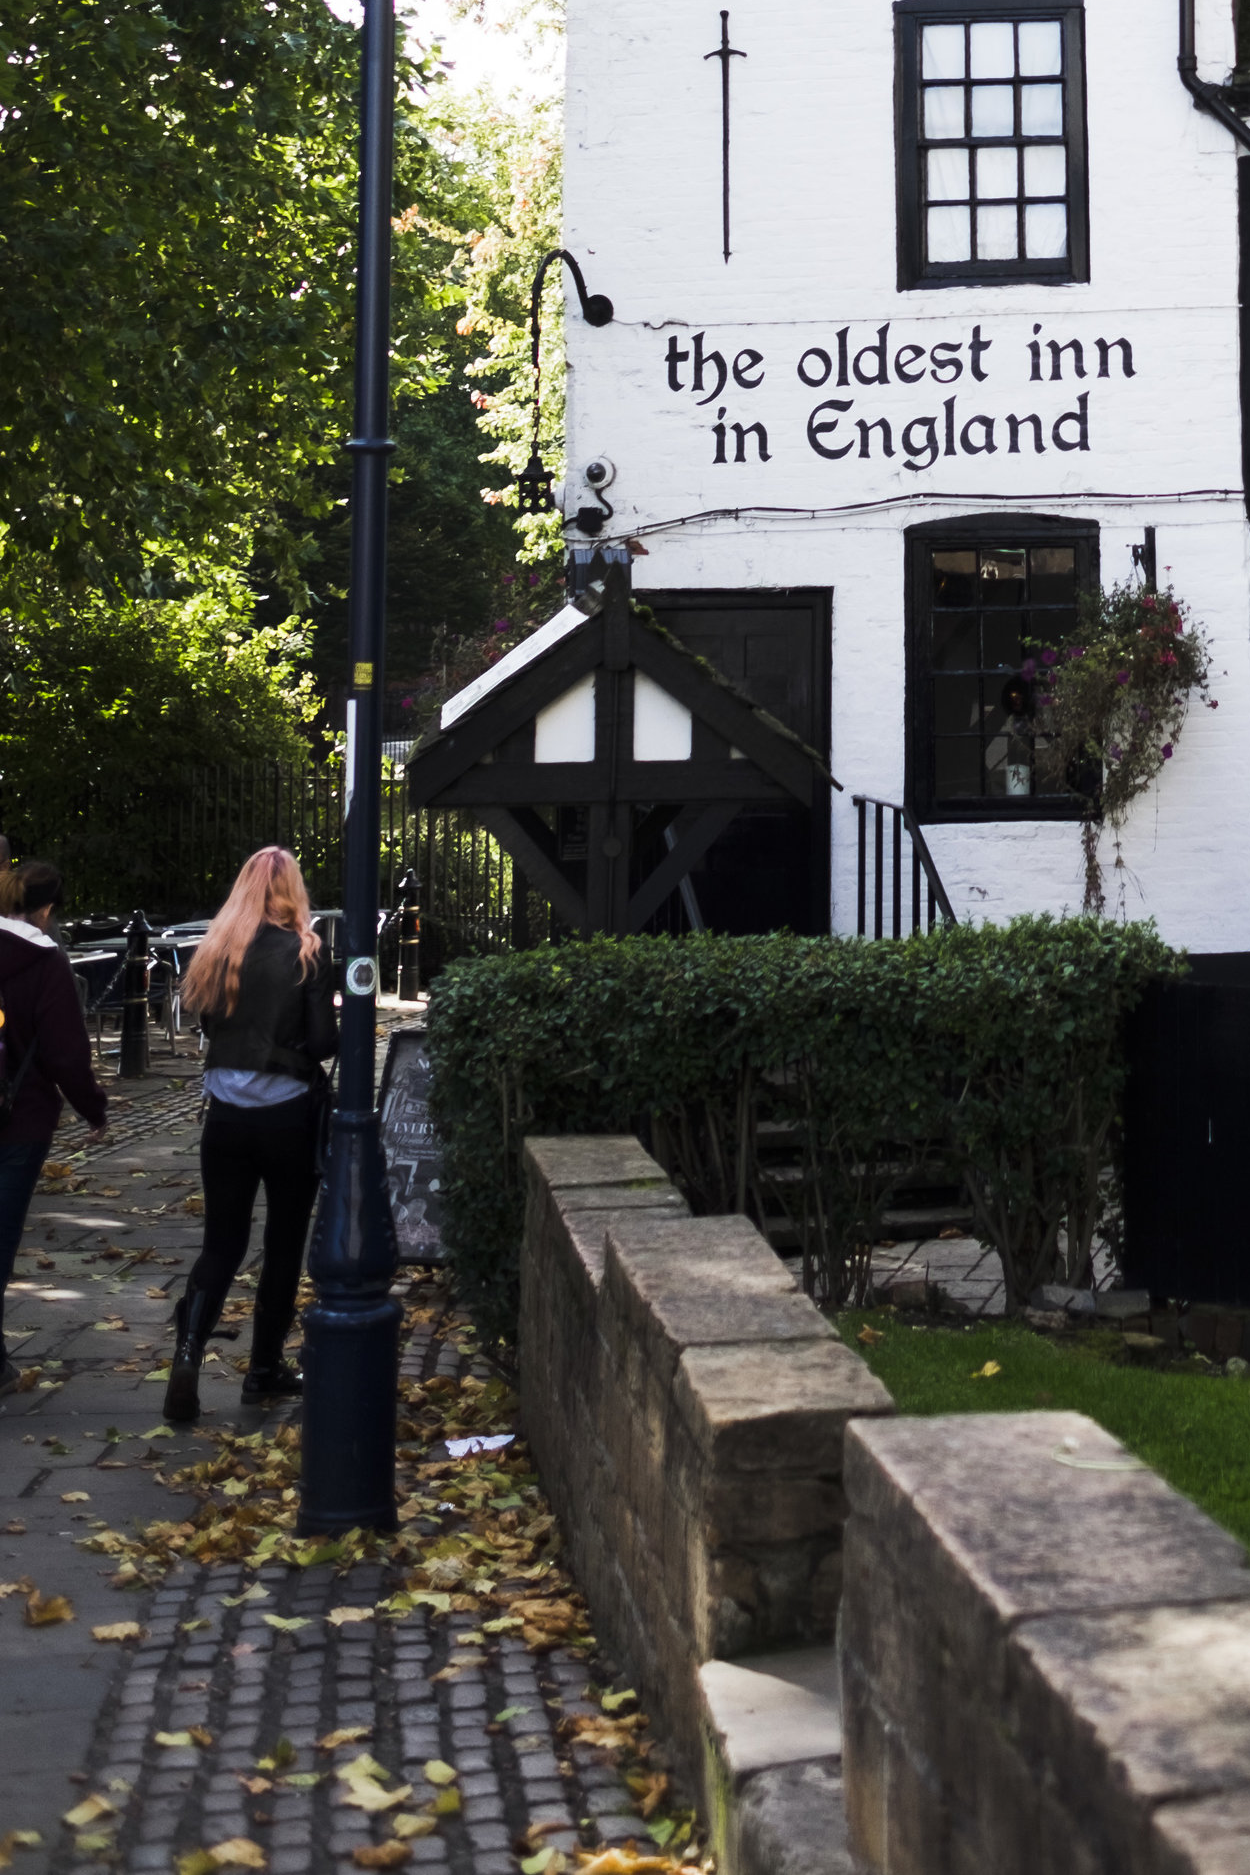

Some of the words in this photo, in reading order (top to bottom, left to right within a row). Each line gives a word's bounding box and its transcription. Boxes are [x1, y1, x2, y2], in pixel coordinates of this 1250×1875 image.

[664, 329, 766, 407] the
[797, 321, 994, 388] oldest
[1026, 322, 1138, 382] inn
[711, 405, 774, 465] in
[806, 389, 1092, 473] England
